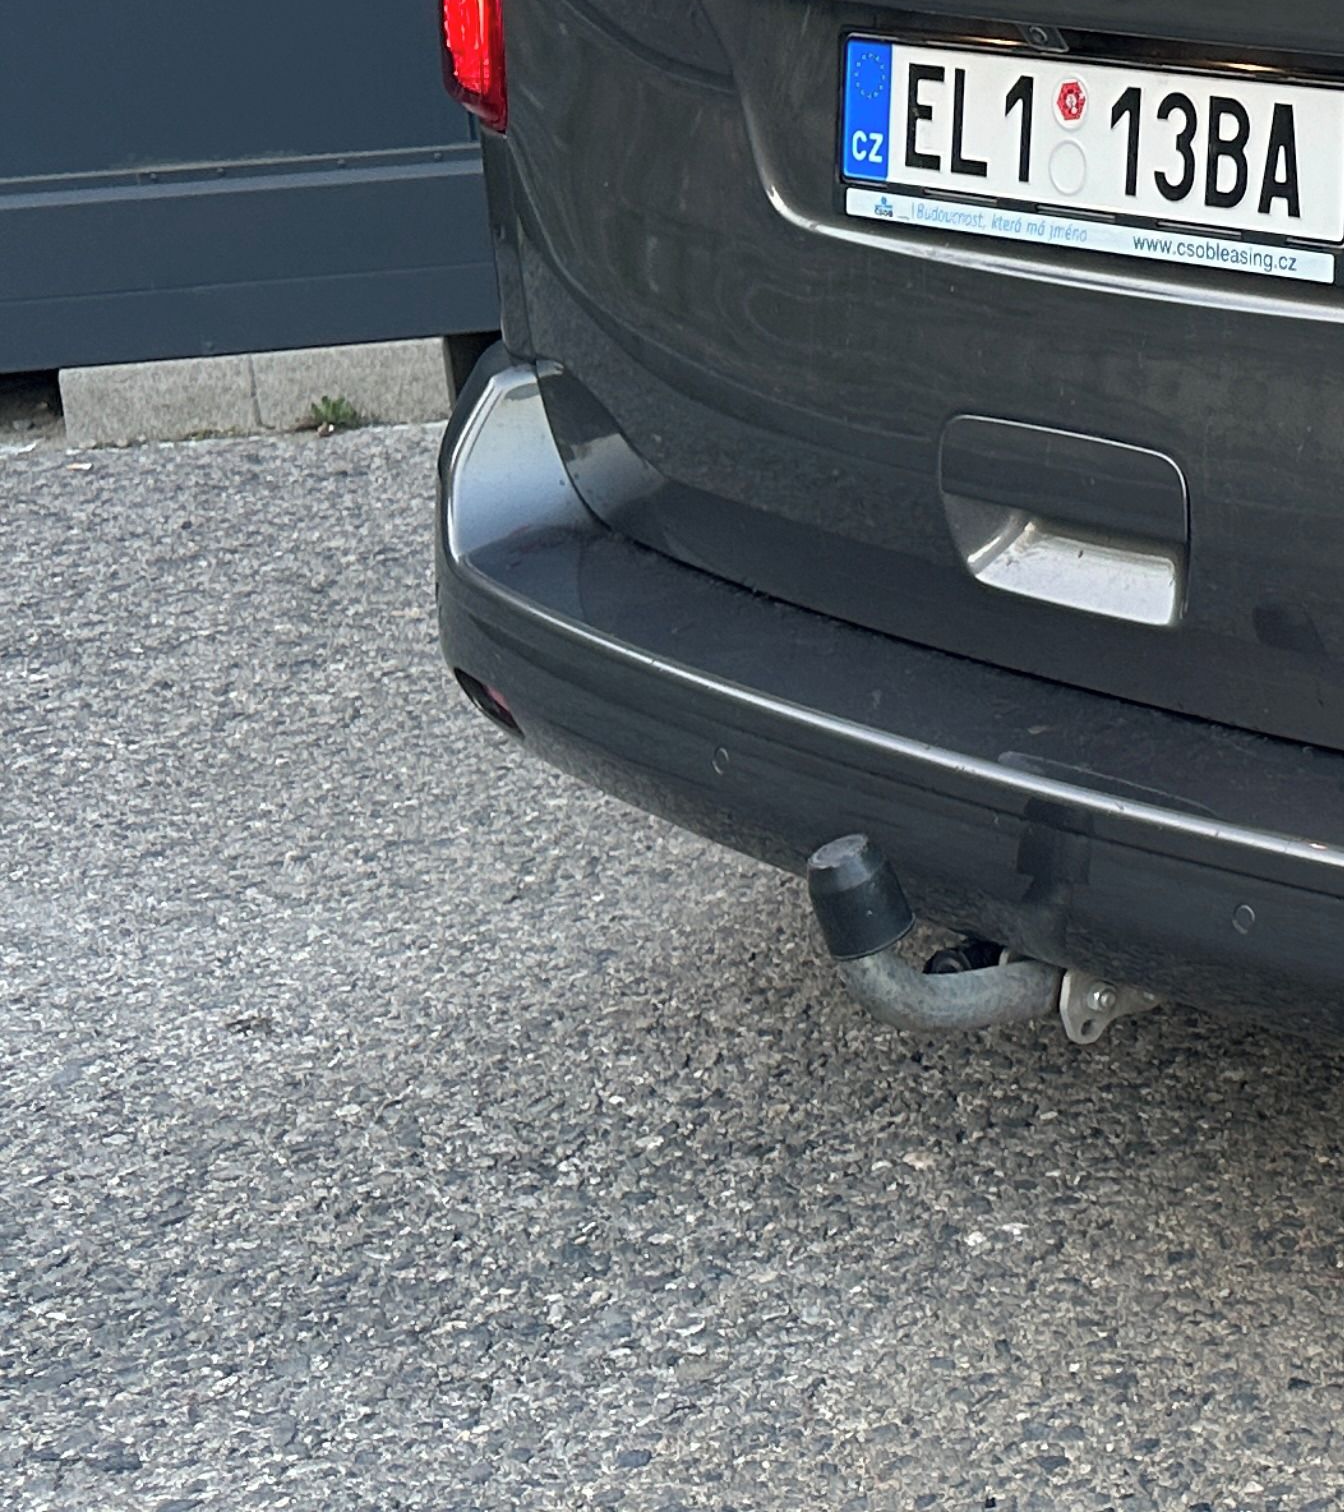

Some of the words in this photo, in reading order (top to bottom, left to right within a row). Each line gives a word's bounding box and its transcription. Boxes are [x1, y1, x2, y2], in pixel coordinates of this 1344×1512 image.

[852, 130, 884, 164] CZ
[904, 63, 1034, 183] EL1
[1110, 86, 1301, 219] 13BA
[1132, 235, 1298, 273] www.csobleasing.cz
